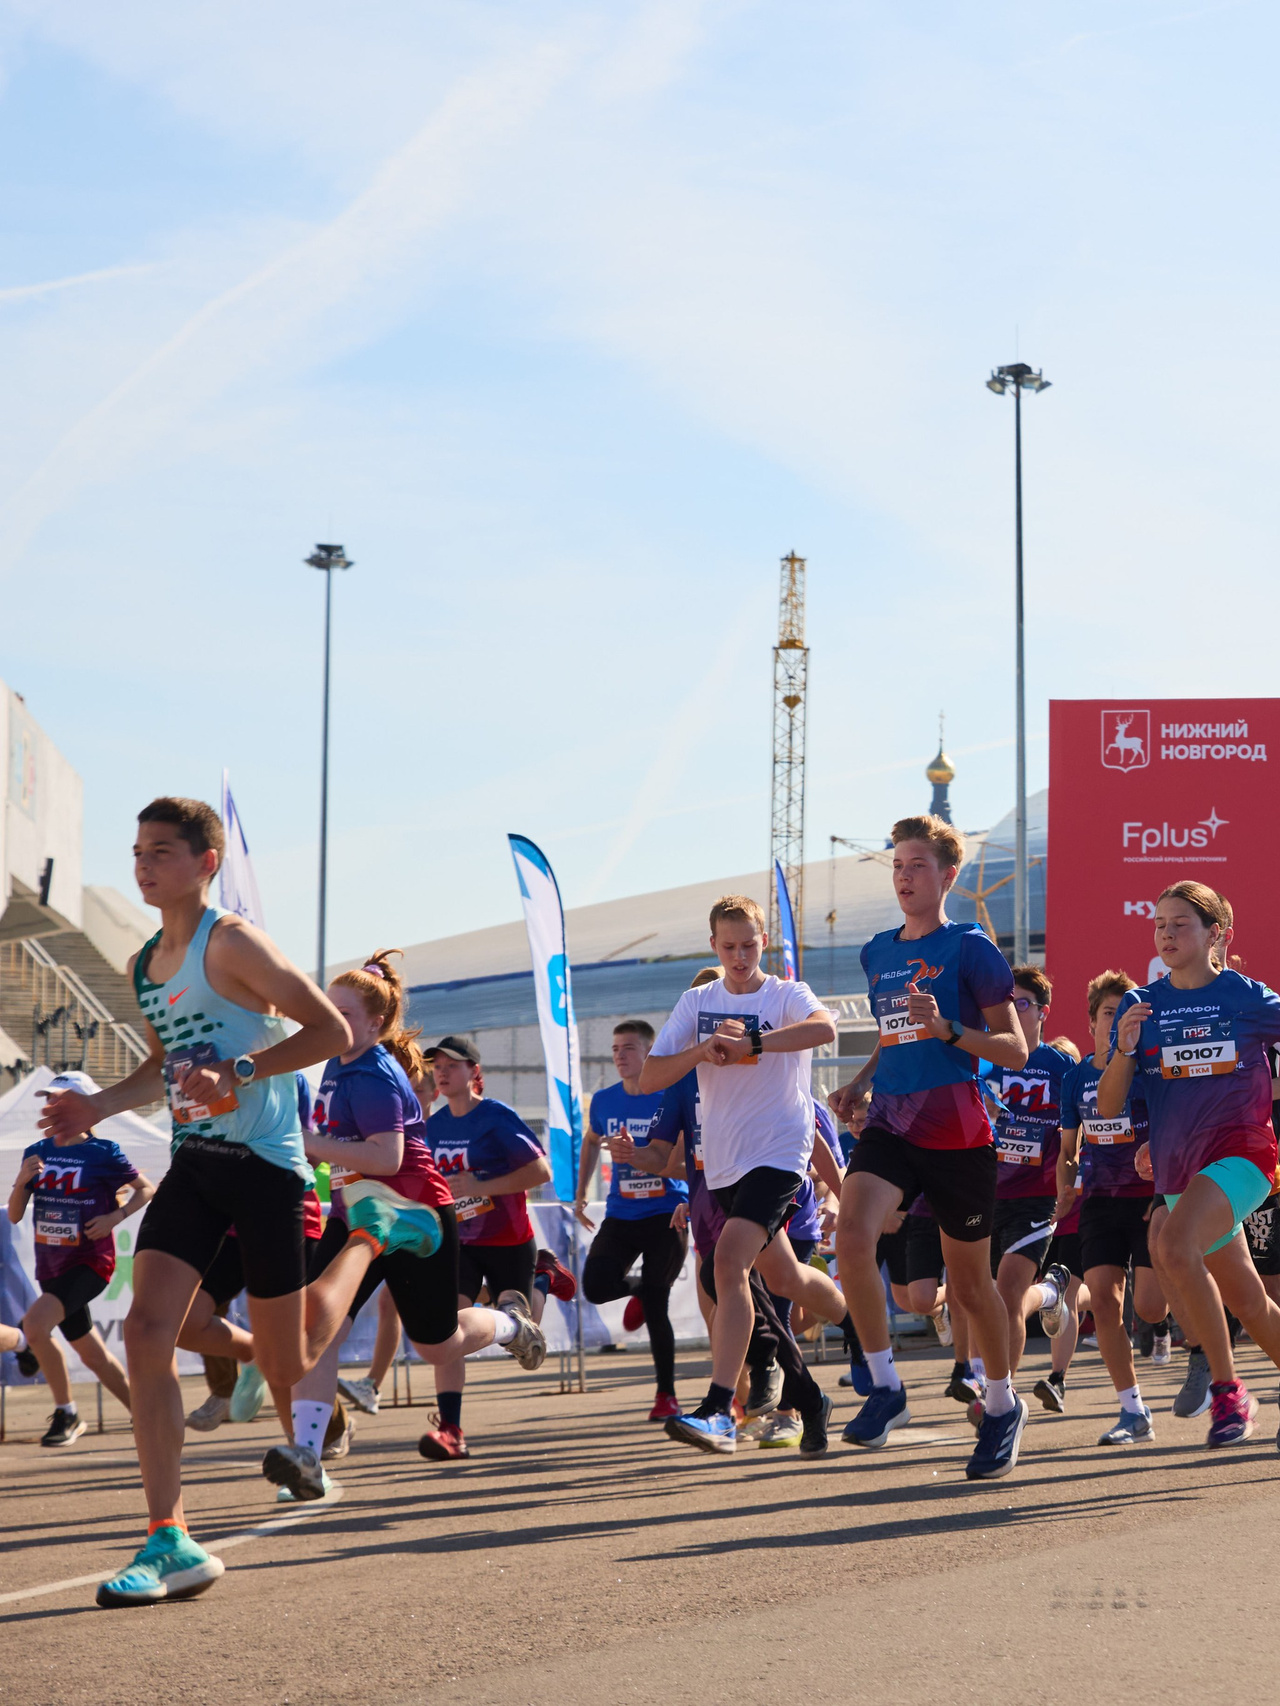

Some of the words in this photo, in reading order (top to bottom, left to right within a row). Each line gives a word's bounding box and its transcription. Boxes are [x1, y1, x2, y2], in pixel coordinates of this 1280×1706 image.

[1161, 719, 1248, 738] НИЖНИЙ
[1161, 743, 1267, 761] НОВГОРОД
[1122, 822, 1209, 854] Fplus
[881, 972, 896, 980] НБД
[1160, 1005, 1220, 1016] МАРАФОН
[886, 1015, 922, 1030] 107
[1174, 1046, 1223, 1061] 10107
[1089, 1122, 1123, 1132] 11035
[1000, 1142, 1034, 1153] 0767
[628, 1181, 653, 1190] 11017
